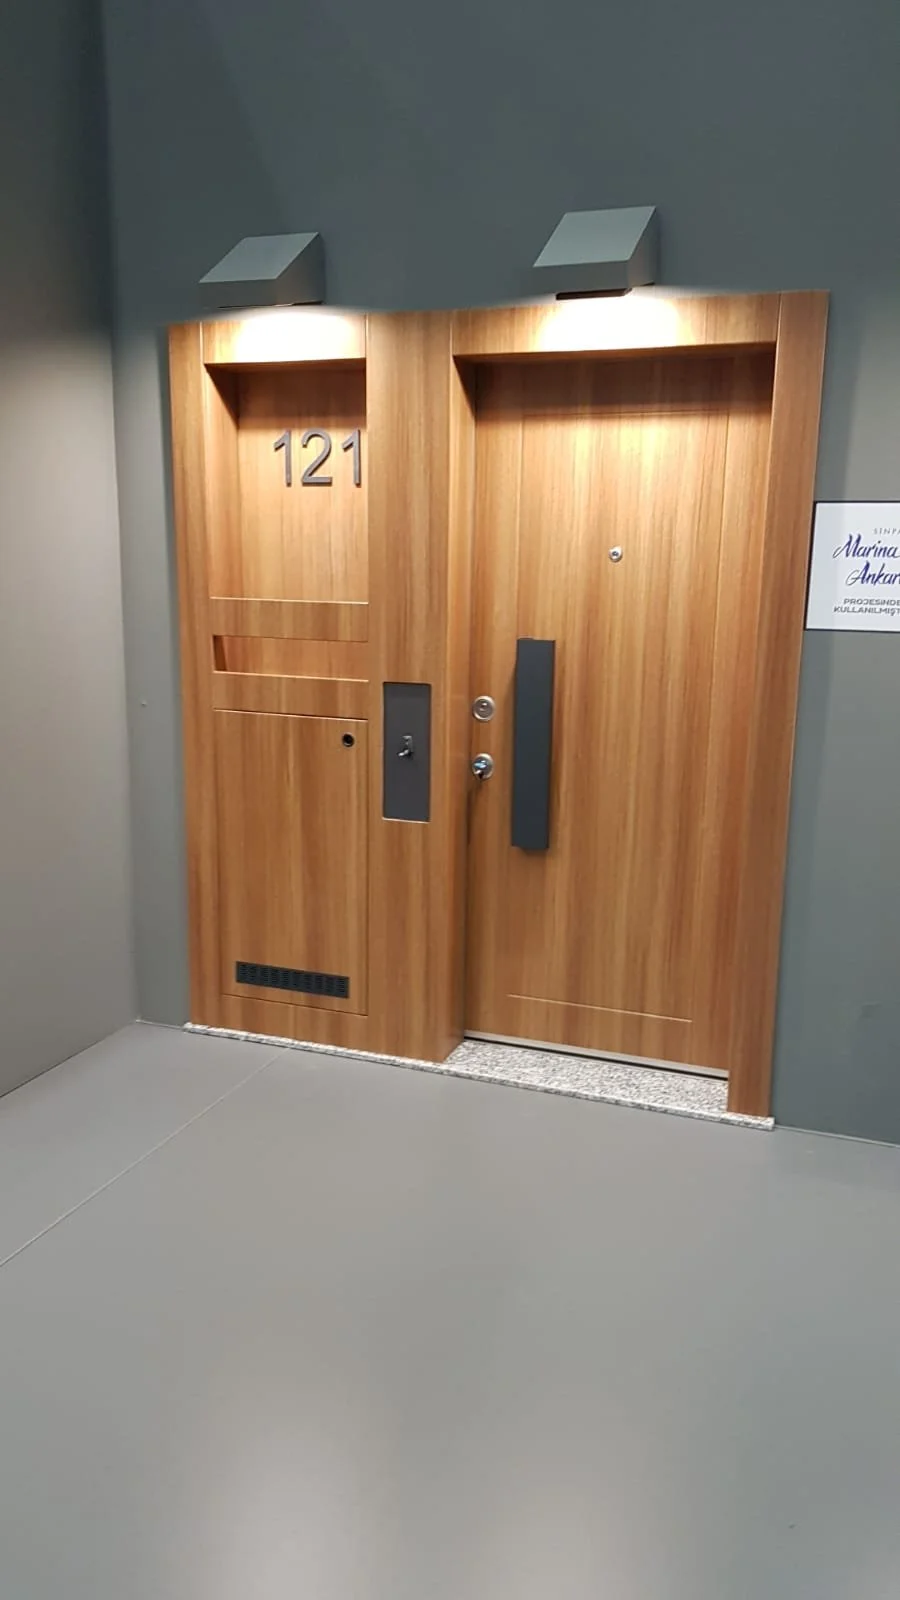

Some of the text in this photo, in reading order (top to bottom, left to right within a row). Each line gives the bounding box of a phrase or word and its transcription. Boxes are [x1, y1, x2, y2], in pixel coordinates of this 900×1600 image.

[274, 428, 361, 487] 121
[832, 534, 900, 558] Marina
[845, 561, 900, 586] Ankar
